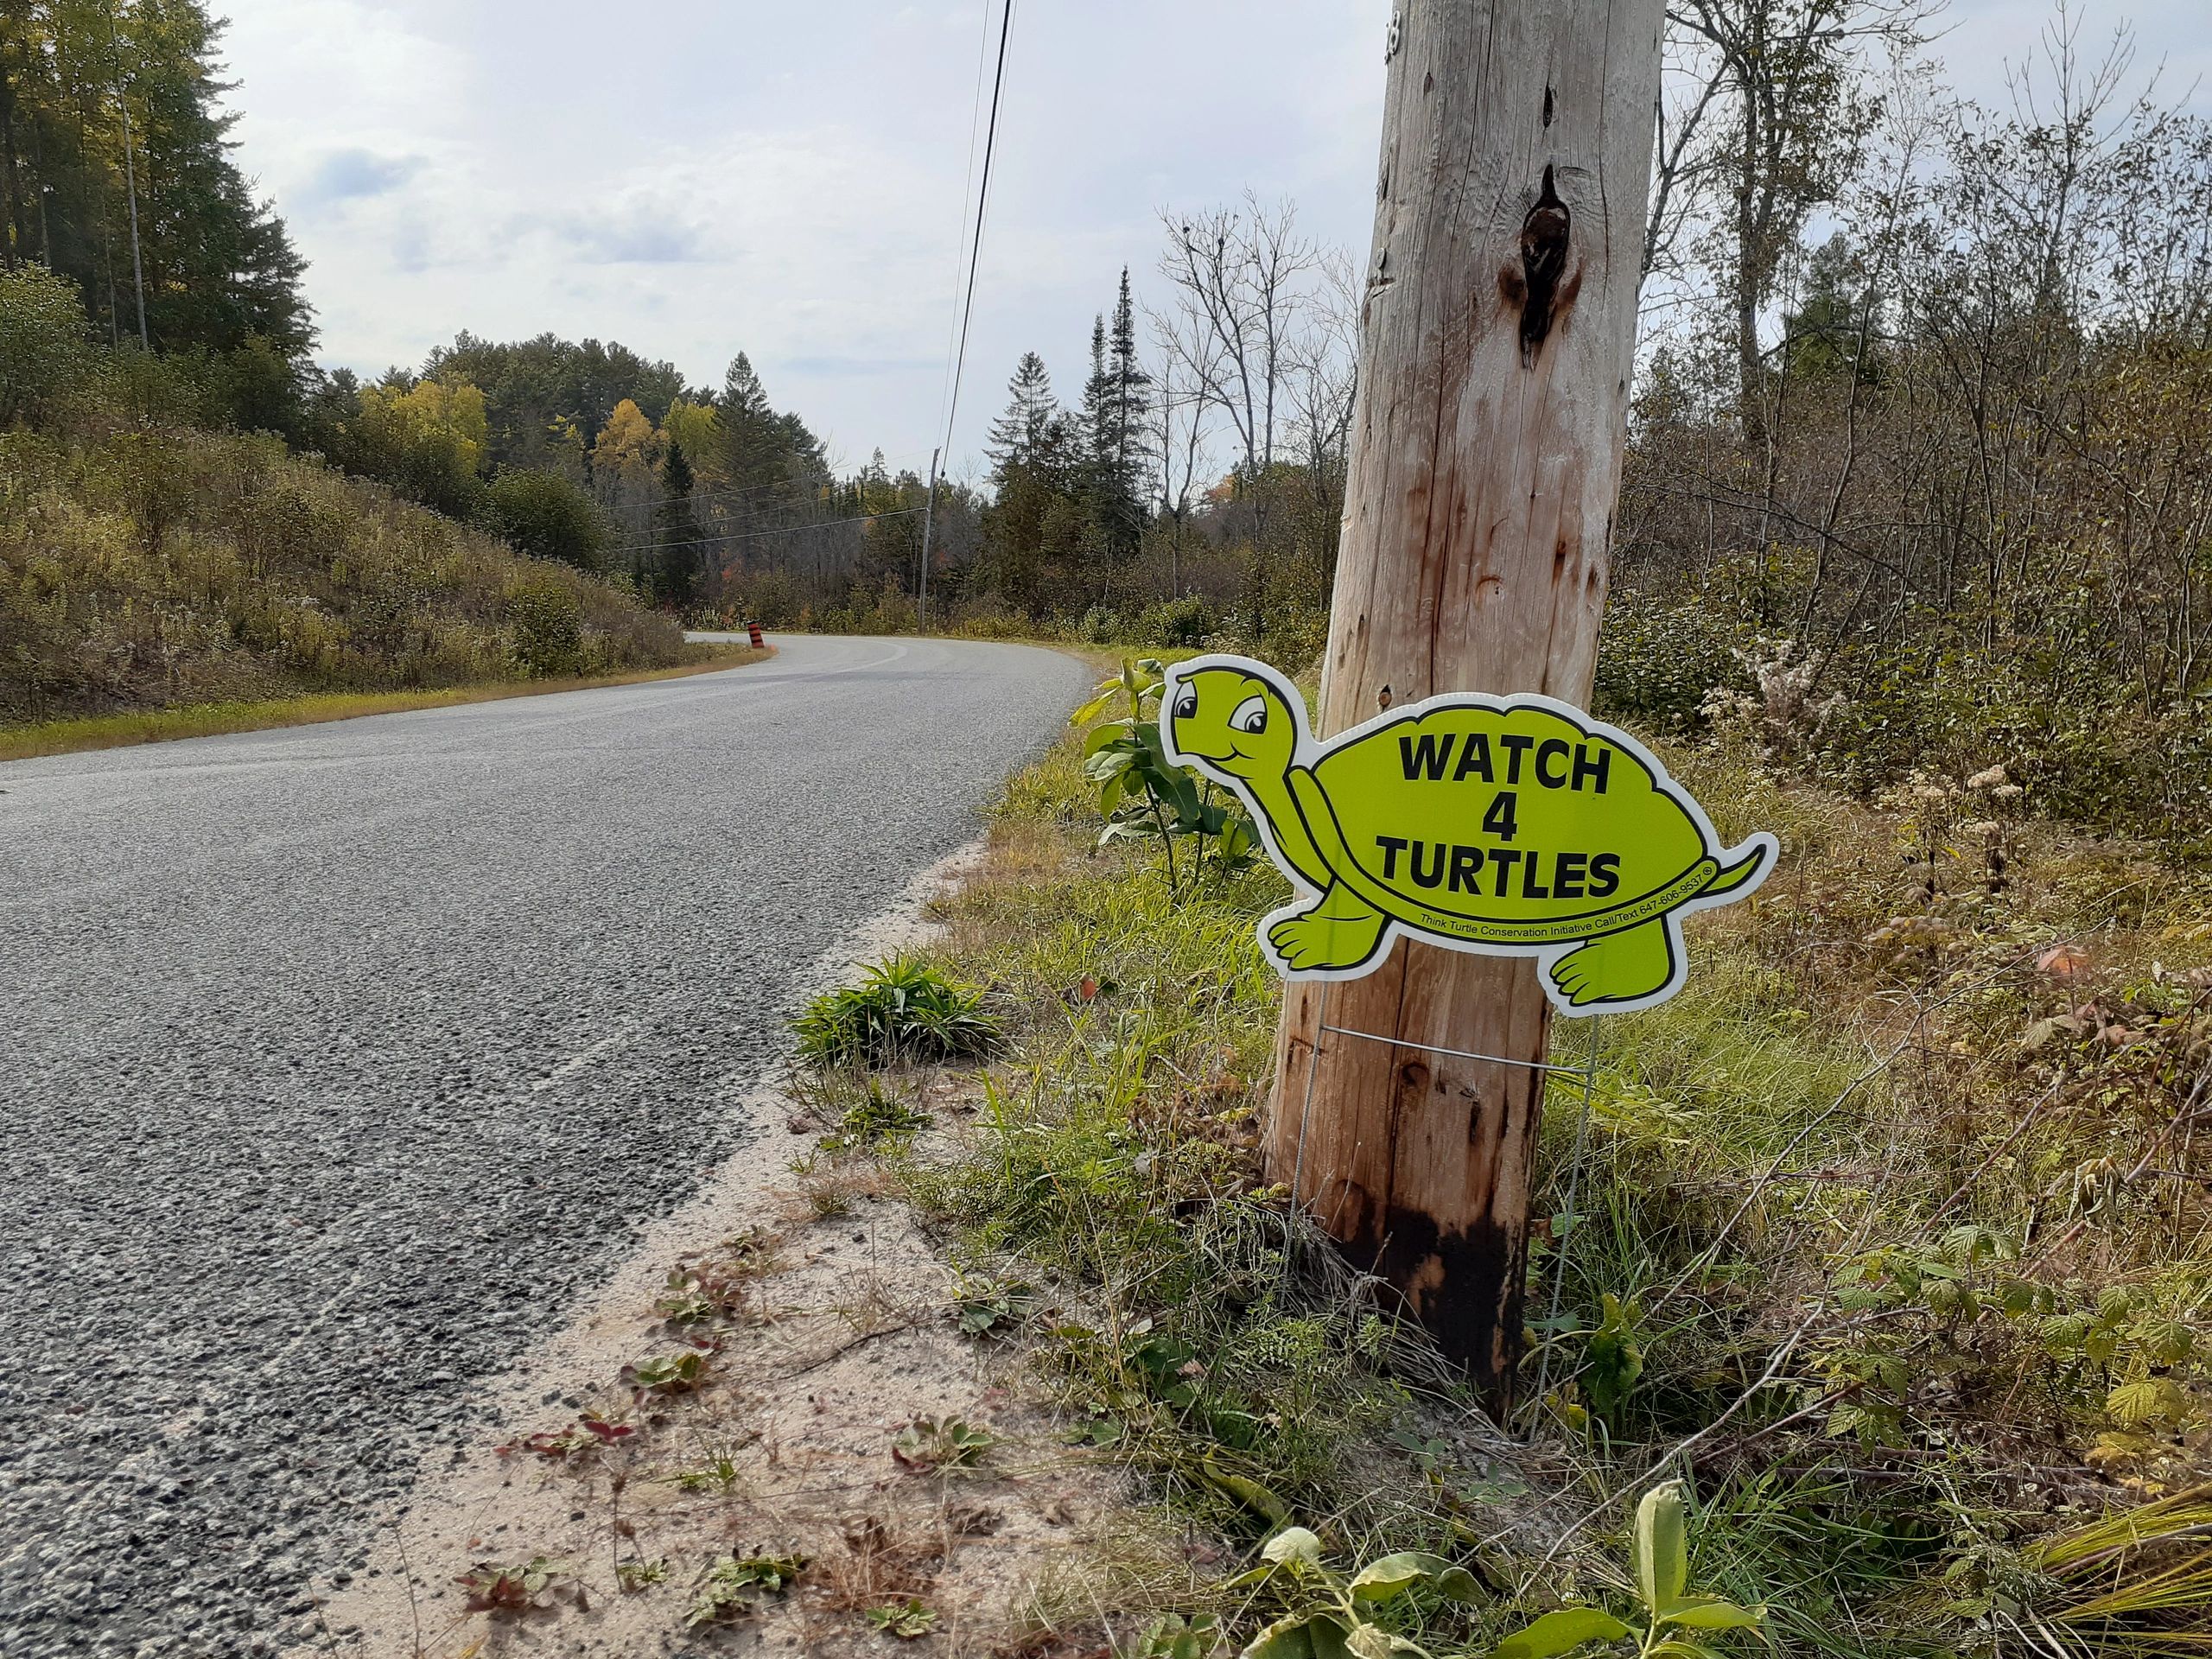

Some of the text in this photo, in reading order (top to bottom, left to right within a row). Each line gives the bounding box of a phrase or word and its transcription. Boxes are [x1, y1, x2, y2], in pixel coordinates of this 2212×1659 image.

[1398, 733, 1611, 795] WATCH
[1481, 791, 1518, 842] 4
[1375, 835, 1621, 899] TURTLES
[1421, 913, 1446, 928] Think
[1450, 920, 1478, 934] Turtle
[1480, 925, 1548, 937] Conservation
[1550, 923, 1592, 936] Initiative
[1594, 909, 1639, 928] Call/Text
[1639, 874, 1703, 914] 647-606-9537
